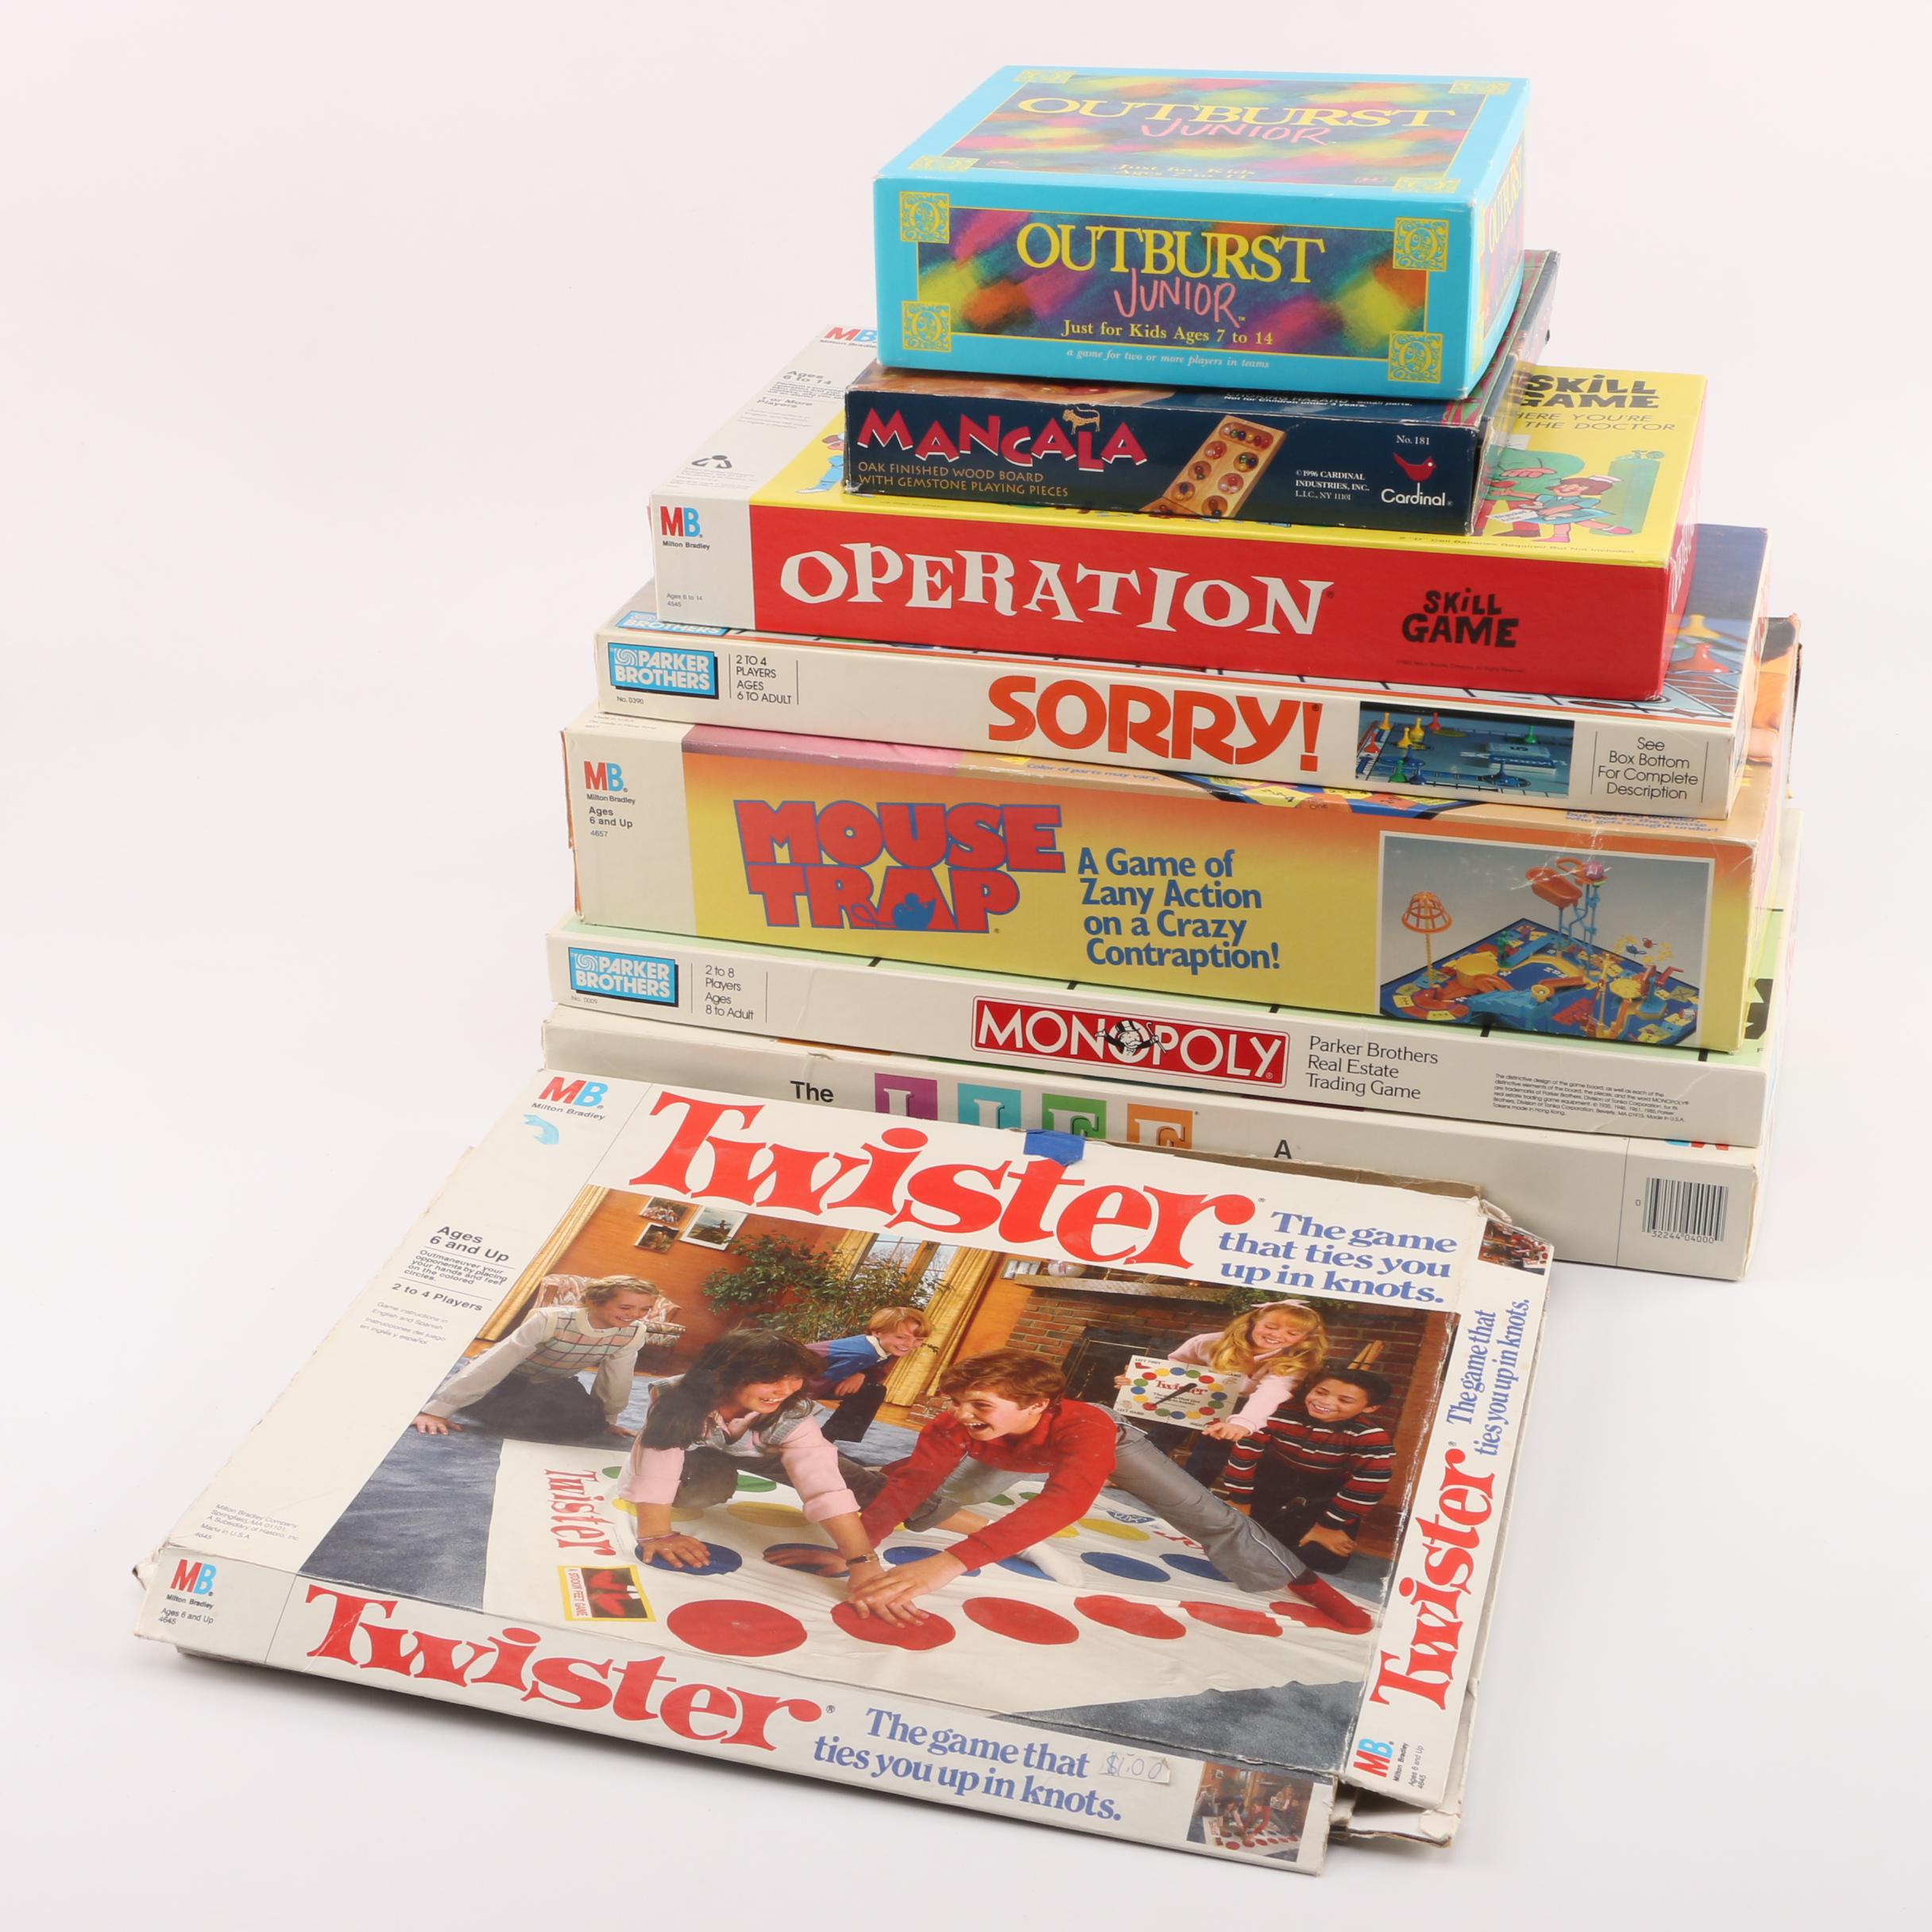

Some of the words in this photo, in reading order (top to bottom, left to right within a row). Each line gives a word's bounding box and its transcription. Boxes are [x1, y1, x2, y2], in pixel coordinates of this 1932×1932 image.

[1018, 97, 1455, 127] OUTBURST
[1142, 118, 1330, 146] JUNIOR
[1017, 222, 1326, 284] OUTBURST
[1114, 268, 1241, 328] JUNIOR
[1061, 319, 1094, 337] Just
[1100, 322, 1122, 337] for
[1129, 323, 1167, 339] Kids
[1174, 326, 1209, 343] Ages
[1216, 329, 1226, 342] 7
[1232, 330, 1248, 344] to
[1255, 332, 1273, 345] 14
[1076, 351, 1103, 361] game
[1103, 350, 1121, 361] for
[1124, 352, 1142, 361] two
[1161, 354, 1184, 364] more
[1188, 354, 1223, 368] players
[1227, 357, 1237, 366] in
[1242, 358, 1270, 369] teams
[1516, 412, 1561, 420] HERE
[1574, 413, 1653, 422] YOU'RE
[1524, 421, 1564, 430] THE
[1575, 422, 1676, 431] DOCTOR
[856, 408, 1147, 472] MANCALA
[1397, 435, 1412, 444] No.
[1415, 436, 1430, 446] 181
[858, 462, 886, 473] OAK
[890, 463, 949, 477] FINISHED
[952, 467, 995, 480] WOOD
[999, 469, 1044, 483] BOARD
[1320, 470, 1366, 481] CARDINAL
[859, 474, 894, 486] WITH
[898, 477, 967, 491] GEMSTONE
[971, 481, 1025, 495] PLAYING
[1030, 485, 1068, 497] PIECES
[1296, 479, 1350, 491] INDUSTRIES,
[1351, 483, 1370, 492] INC.
[1381, 482, 1446, 507] Cardinal
[663, 540, 682, 549] Milton
[685, 542, 710, 551] Bradley
[780, 542, 1335, 635] OPERATION
[1401, 612, 1519, 648] GAME
[638, 651, 709, 674] PARKER
[736, 655, 743, 664] 2
[745, 655, 758, 665] TO
[760, 656, 767, 667] 4
[736, 667, 776, 679] PLAYERS
[615, 666, 710, 691] BROTHERS
[737, 680, 764, 691] AGES
[737, 691, 744, 701] 6
[745, 692, 759, 701] TO
[761, 693, 792, 705] ADULT
[988, 675, 1323, 771] SORRY!
[1636, 736, 1666, 752] See
[1609, 750, 1635, 764] Box
[1639, 752, 1690, 769] Bottom
[1598, 765, 1621, 779] For
[1624, 766, 1698, 787] Complete
[586, 794, 609, 802] Milton
[609, 795, 636, 806] Bradley
[1606, 782, 1688, 802] Description
[589, 806, 614, 817] Ages
[589, 816, 596, 825] 6
[598, 817, 616, 827] and
[620, 819, 633, 829] Up
[733, 799, 1066, 873] MOUSE
[1077, 847, 1099, 875] A
[1105, 848, 1196, 877] Game
[1204, 849, 1235, 878] of
[745, 862, 1021, 933] TRAP
[1080, 877, 1155, 914] Zany
[1164, 879, 1262, 909] Action
[1084, 915, 1122, 936] on
[1130, 916, 1150, 936] a
[1157, 910, 1247, 946] Crazy
[598, 956, 670, 980] PARKER
[1086, 937, 1281, 976] Contraption!
[575, 969, 670, 998] BROTHERS
[705, 965, 712, 974] 2
[714, 966, 724, 976] to
[728, 968, 735, 978] 8
[705, 978, 741, 992] Players
[705, 992, 732, 1005] Ages
[705, 1005, 712, 1015] 8
[714, 1007, 724, 1017] to
[726, 1008, 755, 1021] Adult
[977, 1004, 1282, 1077] MONOPOLY
[1309, 1035, 1363, 1056] Parker
[1366, 1042, 1439, 1065] Brothers
[1308, 1054, 1343, 1072] Real
[1347, 1058, 1399, 1079] Estate
[790, 1080, 835, 1103] The
[1305, 1072, 1366, 1097] Trading
[1370, 1080, 1421, 1099] Game
[531, 1102, 564, 1115] Milton
[566, 1108, 605, 1122] Bradley
[629, 1091, 1255, 1269] Twister
[436, 1226, 484, 1244] Ages
[1271, 1211, 1347, 1240] The
[1347, 1227, 1458, 1253] game
[1652, 1231, 1680, 1240] 32244
[1684, 1234, 1714, 1244] 04000
[429, 1235, 441, 1245] 6
[445, 1241, 481, 1255] and
[484, 1249, 510, 1262] Up
[1219, 1231, 1298, 1260] that
[1305, 1244, 1374, 1269] ties
[1377, 1257, 1451, 1278] you
[404, 1269, 436, 1281] circles.
[411, 1259, 433, 1269] your
[434, 1265, 464, 1277] hands
[464, 1272, 483, 1281] and
[483, 1276, 504, 1285] feet
[415, 1254, 463, 1270] opponents
[475, 1269, 508, 1282] placing
[419, 1250, 481, 1269] Outmaneuver
[481, 1265, 504, 1275] your
[423, 1266, 438, 1275] the
[439, 1273, 476, 1285] colored
[1220, 1262, 1271, 1285] up
[1274, 1265, 1315, 1288] in
[1321, 1270, 1444, 1303] knots.
[404, 1285, 419, 1295] to
[433, 1293, 484, 1312] Players
[544, 1469, 616, 1556] Twister
[1369, 1447, 1496, 1710] Twister
[305, 1583, 823, 1752] Twister
[866, 1707, 928, 1746] The
[928, 1728, 1020, 1765] game
[1022, 1742, 1090, 1779] that
[813, 1735, 871, 1770] ties
[871, 1753, 934, 1783] you
[937, 1765, 981, 1796] up
[984, 1766, 1016, 1799] in
[1019, 1774, 1122, 1822] knots.
